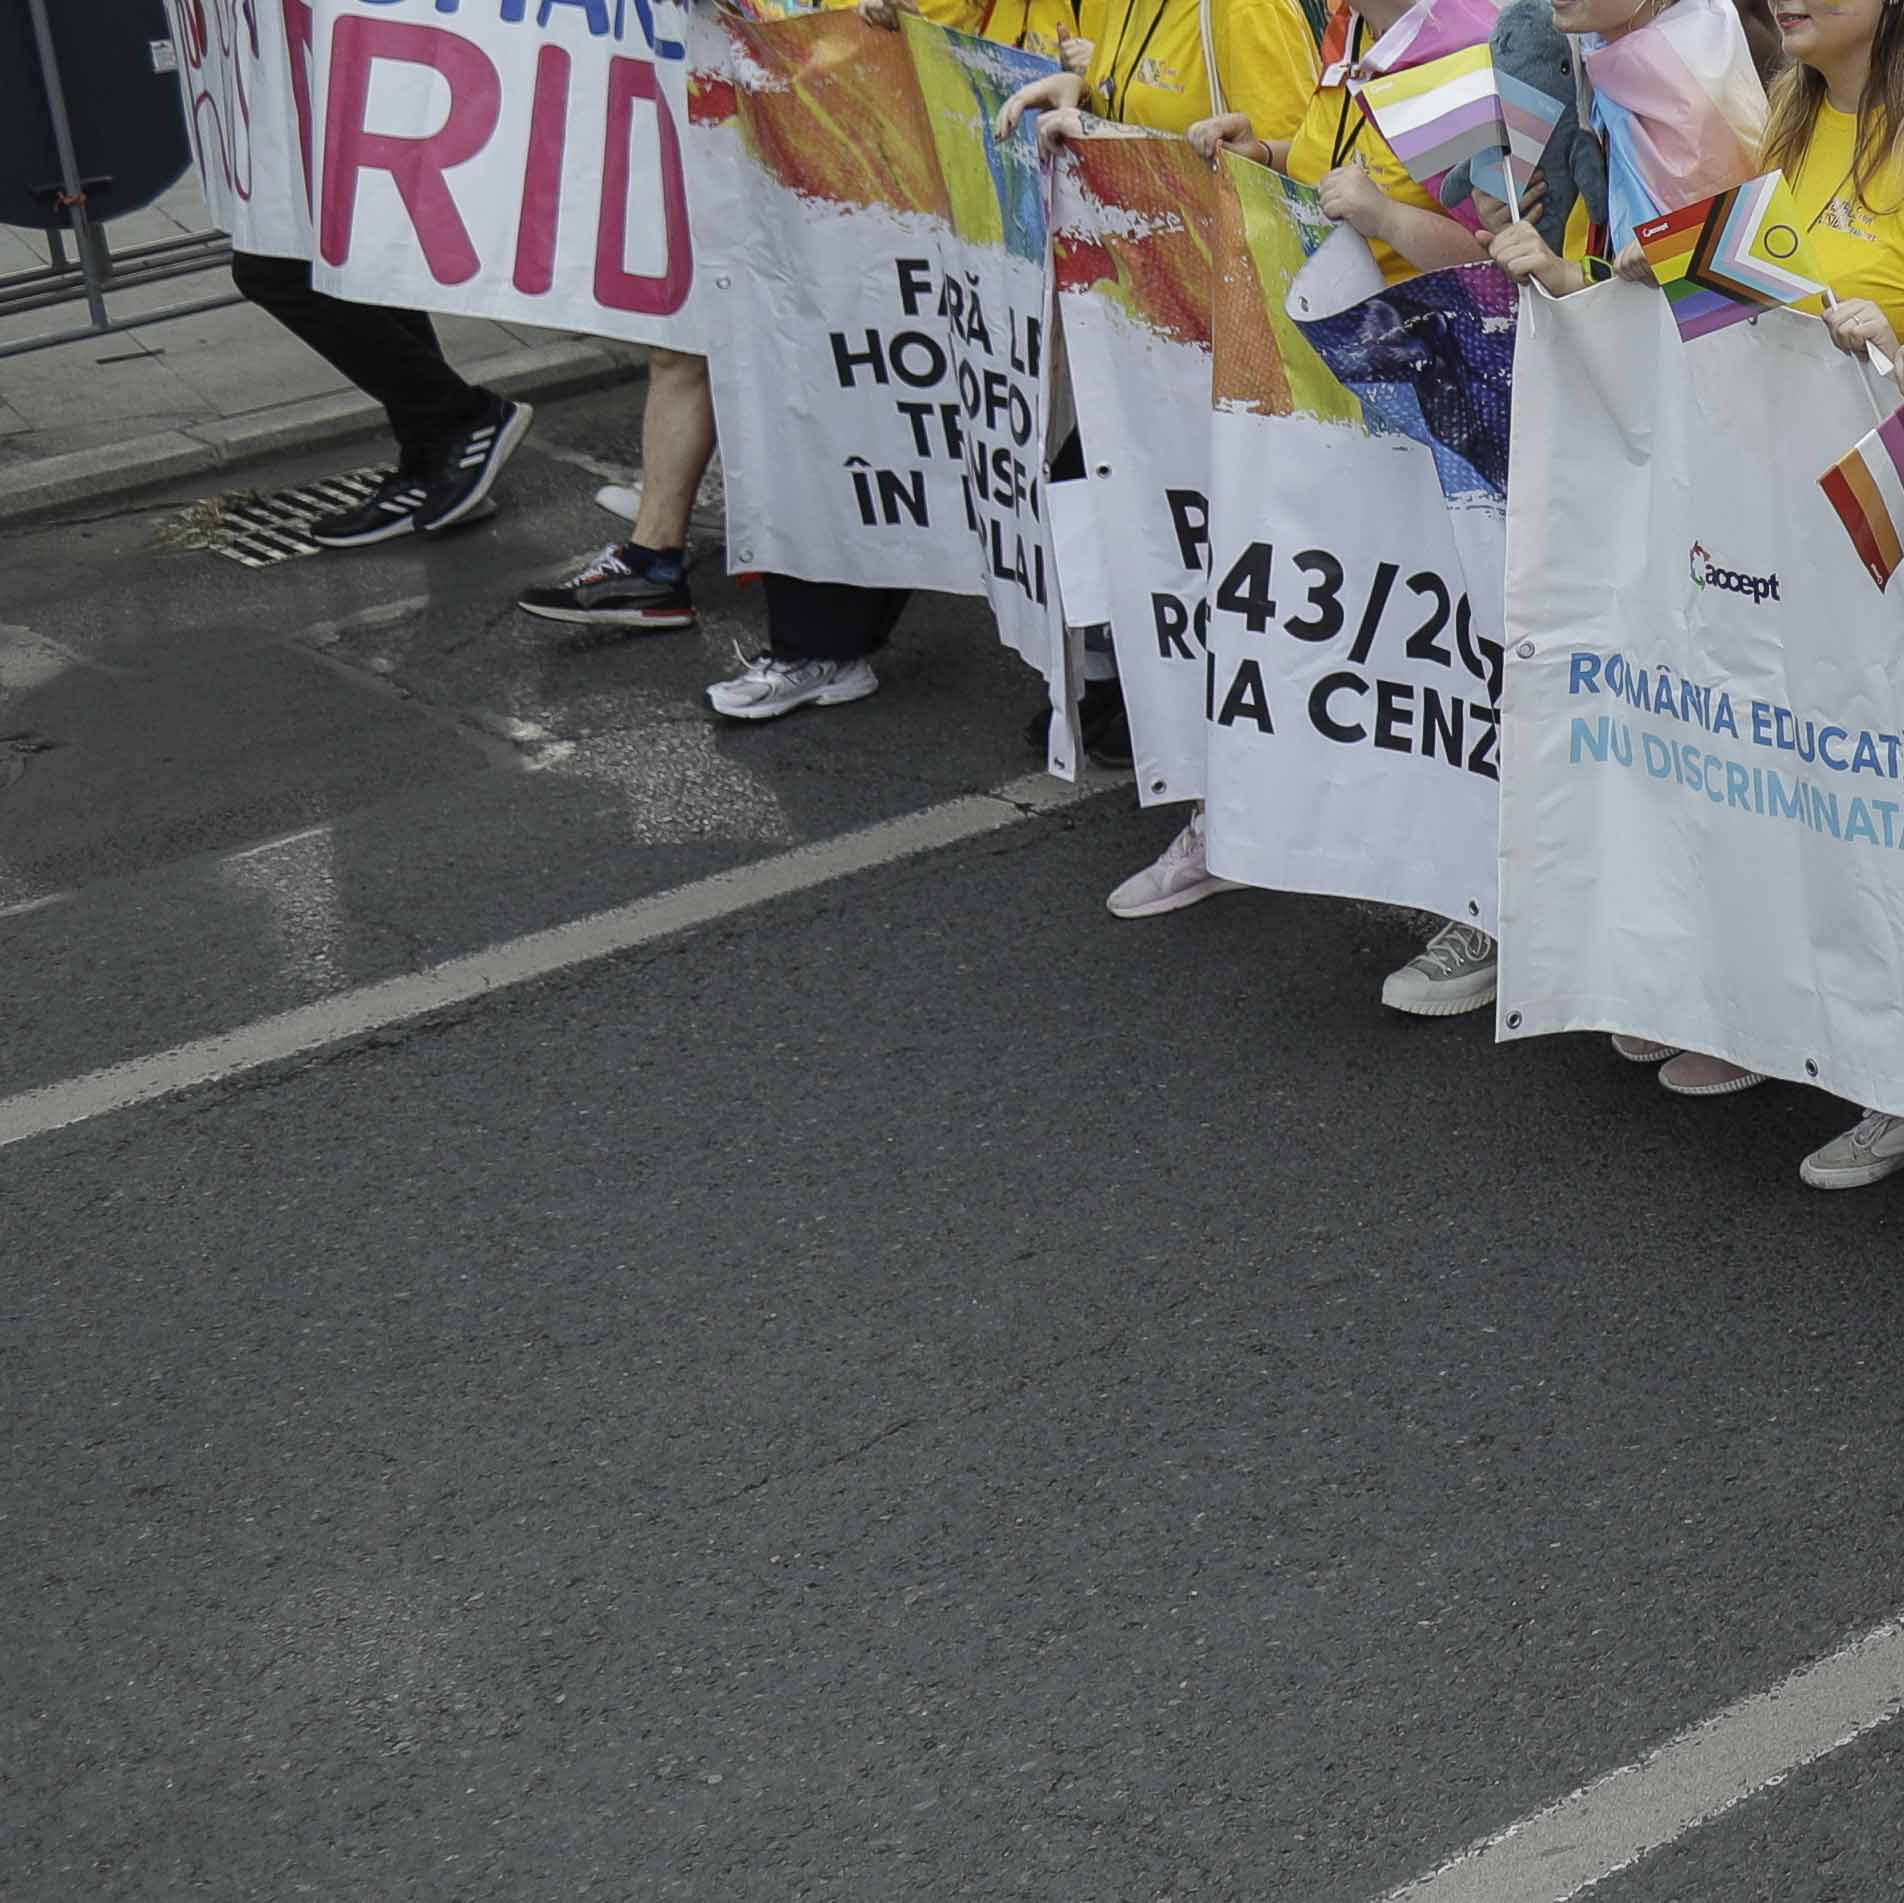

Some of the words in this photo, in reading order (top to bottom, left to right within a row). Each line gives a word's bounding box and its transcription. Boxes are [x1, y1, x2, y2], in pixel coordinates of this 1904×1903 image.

[843, 456, 930, 528] ÎN
[1704, 563, 1781, 604] accept
[1308, 671, 1500, 783] CENZ
[1569, 652, 1739, 739] ROMÂNIA
[1569, 715, 1633, 768] NU
